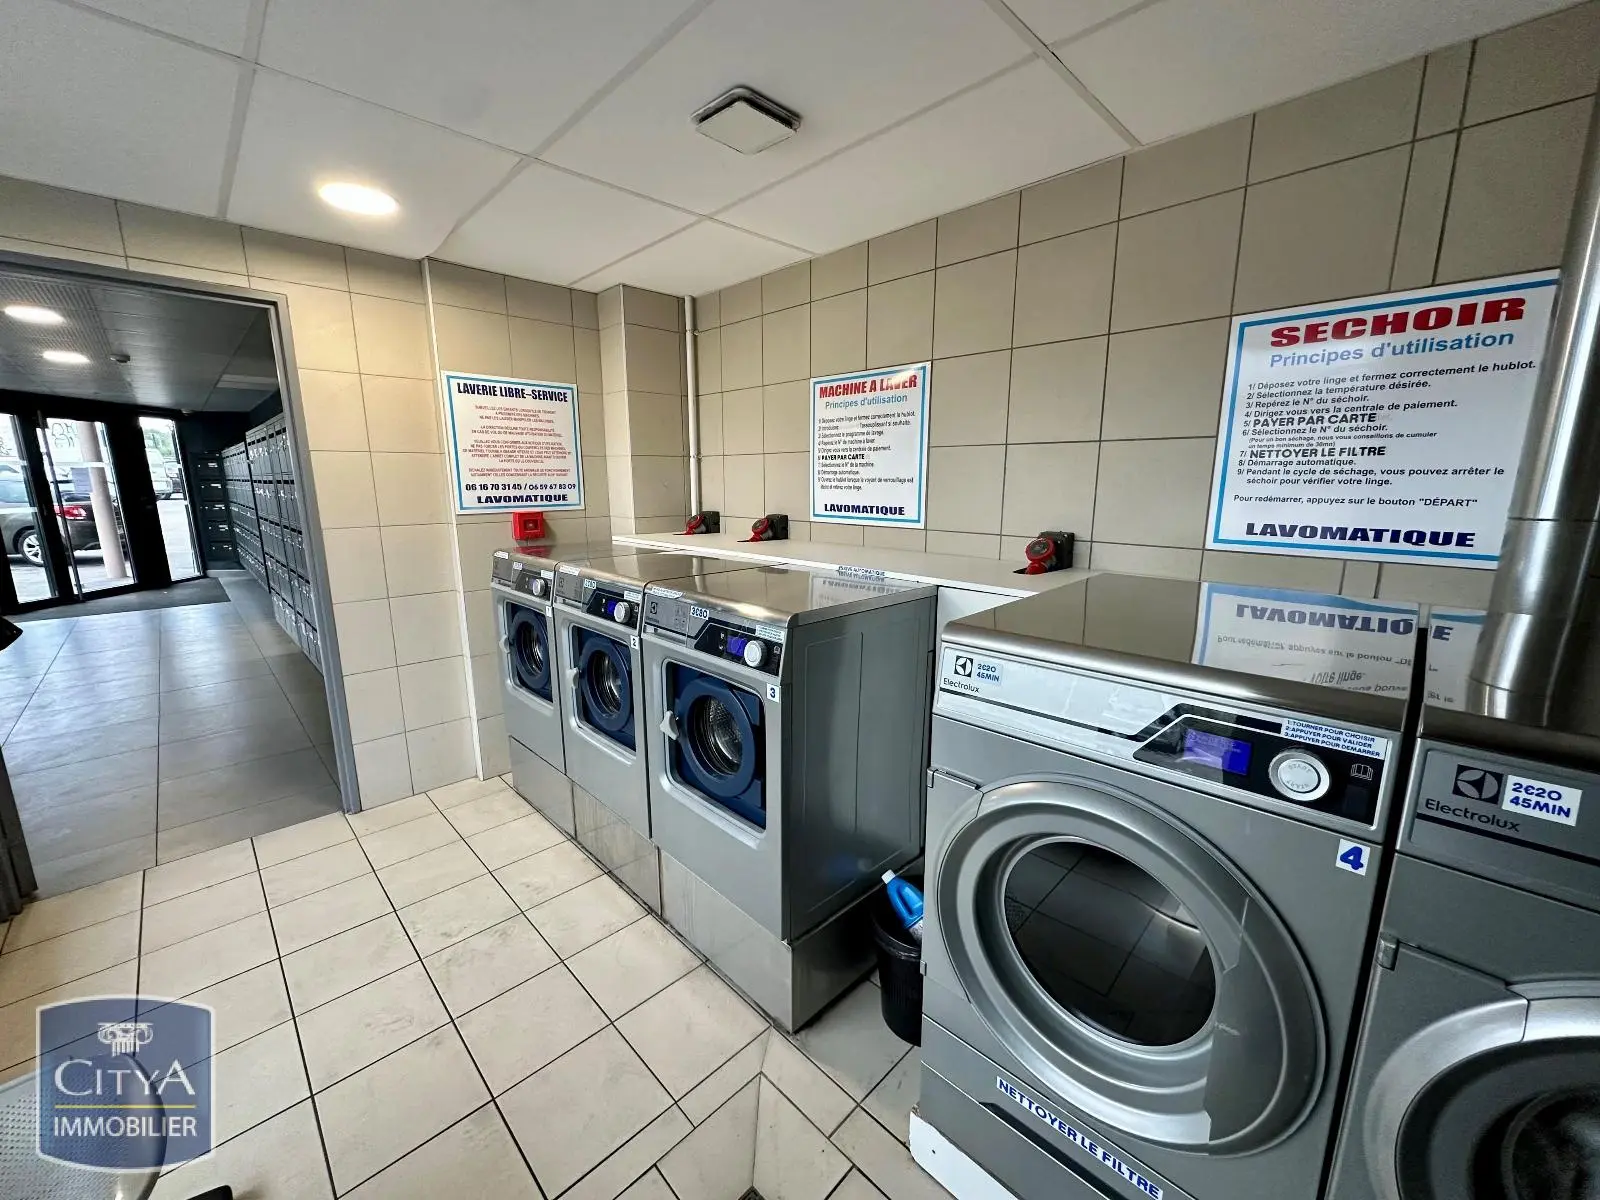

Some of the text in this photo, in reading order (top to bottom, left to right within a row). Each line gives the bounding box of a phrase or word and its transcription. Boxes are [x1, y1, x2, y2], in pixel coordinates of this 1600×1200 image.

[1270, 297, 1526, 348] SECHOIR
[1270, 331, 1515, 367] Principes d'utilisation
[1257, 381, 1295, 391] Déposez
[1323, 376, 1347, 386] linge
[1362, 372, 1397, 381] fermez
[1399, 365, 1475, 378] correctement
[1478, 364, 1489, 373] le
[1492, 360, 1536, 372] hublot.
[457, 382, 568, 402] LAVERIE LIBRE-SERVICE
[819, 381, 867, 398] MACHINE
[869, 379, 877, 392] A
[1256, 388, 1312, 399] Sélectionnez
[1326, 384, 1386, 394] température
[1388, 380, 1431, 390] désirée.
[825, 394, 908, 410] Principes d'utilisation
[1254, 410, 1284, 419] Dirigez
[1344, 404, 1384, 413] centrale
[1403, 400, 1458, 411] paiement.
[1255, 399, 1290, 409] Repérez
[1331, 394, 1369, 403] séchoir.
[1252, 417, 1294, 428] PAYER
[1297, 415, 1324, 426] PAR
[1328, 413, 1377, 425] CARTE
[1251, 427, 1306, 436] Sélectionnez
[1333, 425, 1346, 433] du
[1348, 423, 1388, 432] séchoir.
[1249, 448, 1318, 459] NETTOYER
[1321, 447, 1336, 457] LE
[1338, 446, 1386, 457] FILTRE
[1247, 459, 1294, 468] Démarrage
[1295, 458, 1356, 467] automatique.
[1292, 468, 1317, 477] cycle
[1333, 467, 1377, 477] séchage,
[1408, 468, 1448, 477] pouvez
[1451, 467, 1491, 475] arrêter
[1494, 467, 1505, 475] le
[1246, 477, 1278, 485] séchoir
[1280, 478, 1300, 486] pour
[1302, 477, 1334, 485] vérifier
[1365, 478, 1393, 486] linge.
[476, 494, 568, 504] LAVOMATIQUE
[1233, 494, 1253, 502] Pour
[1254, 495, 1304, 504] redémarrer,
[1306, 497, 1346, 505] appuyez
[1366, 497, 1376, 505] le
[1378, 498, 1416, 506] bouton
[1419, 497, 1478, 507] "DÉPART"
[824, 504, 905, 515] LAVOMATIQUE
[1245, 522, 1476, 547] LAVOMATIQUE
[632, 638, 638, 648] 2
[769, 688, 776, 698] 3
[943, 678, 980, 693] Electrolux
[1322, 733, 1342, 742] POUR
[1343, 738, 1372, 749] VALIDER
[1324, 727, 1344, 736] POUR
[1345, 731, 1375, 743] CHOISIR
[1320, 740, 1340, 749] POUR
[1512, 782, 1562, 801] 2€20
[1509, 795, 1572, 818] 45MIN
[1425, 798, 1521, 832] Electrolux
[1340, 846, 1364, 870] 4
[999, 1078, 1159, 1200] NETTOYER LE FILTRE
